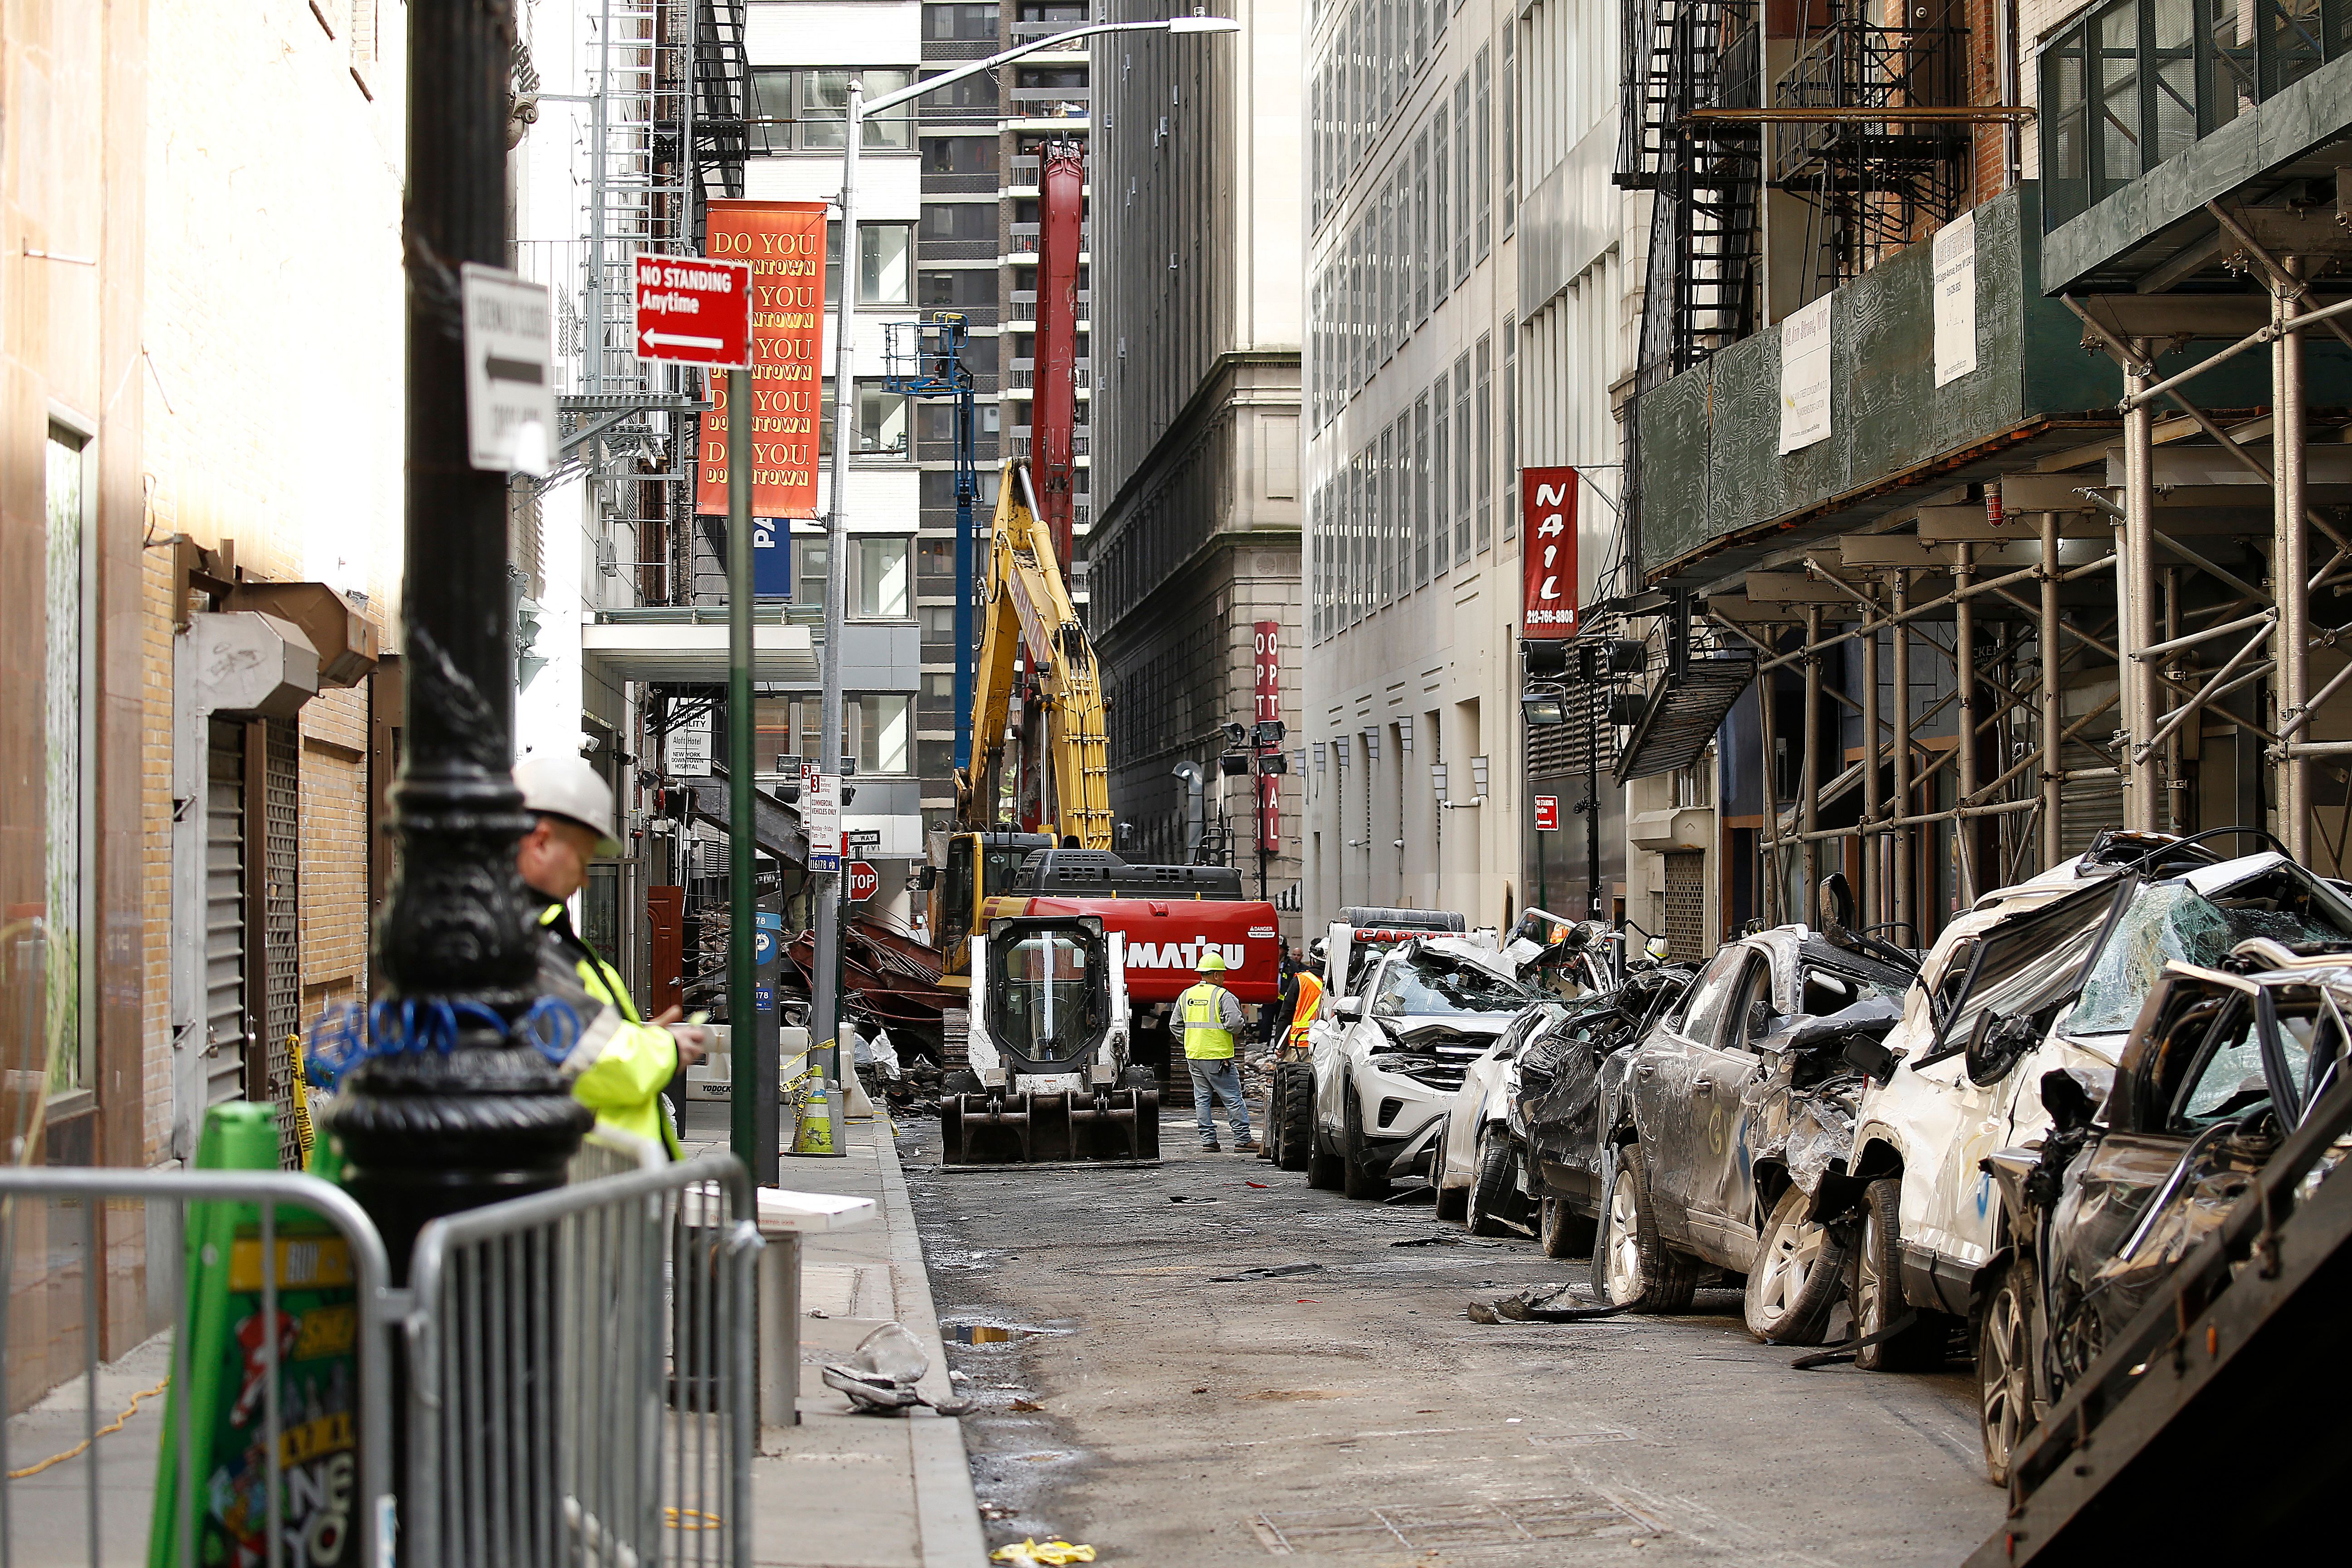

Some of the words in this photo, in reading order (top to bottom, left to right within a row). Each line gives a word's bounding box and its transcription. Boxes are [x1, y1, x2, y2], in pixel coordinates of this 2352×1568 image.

[713, 232, 752, 253] DO
[759, 233, 817, 255] YOU.
[640, 265, 662, 287] NO
[663, 267, 732, 294] STANDING
[641, 289, 700, 316] Anytime
[758, 286, 816, 308] YOU.
[756, 338, 813, 360] YOU.
[754, 390, 812, 412] YOU.
[752, 443, 810, 466] YOU.
[1536, 483, 1566, 600] NAIL
[673, 736, 686, 745] Aloft
[687, 737, 701, 745] Hotel
[1268, 632, 1279, 840] OPTAL
[803, 765, 809, 778] 3
[812, 776, 818, 791] 3
[810, 859, 827, 869] 116178
[851, 874, 875, 889] TOP
